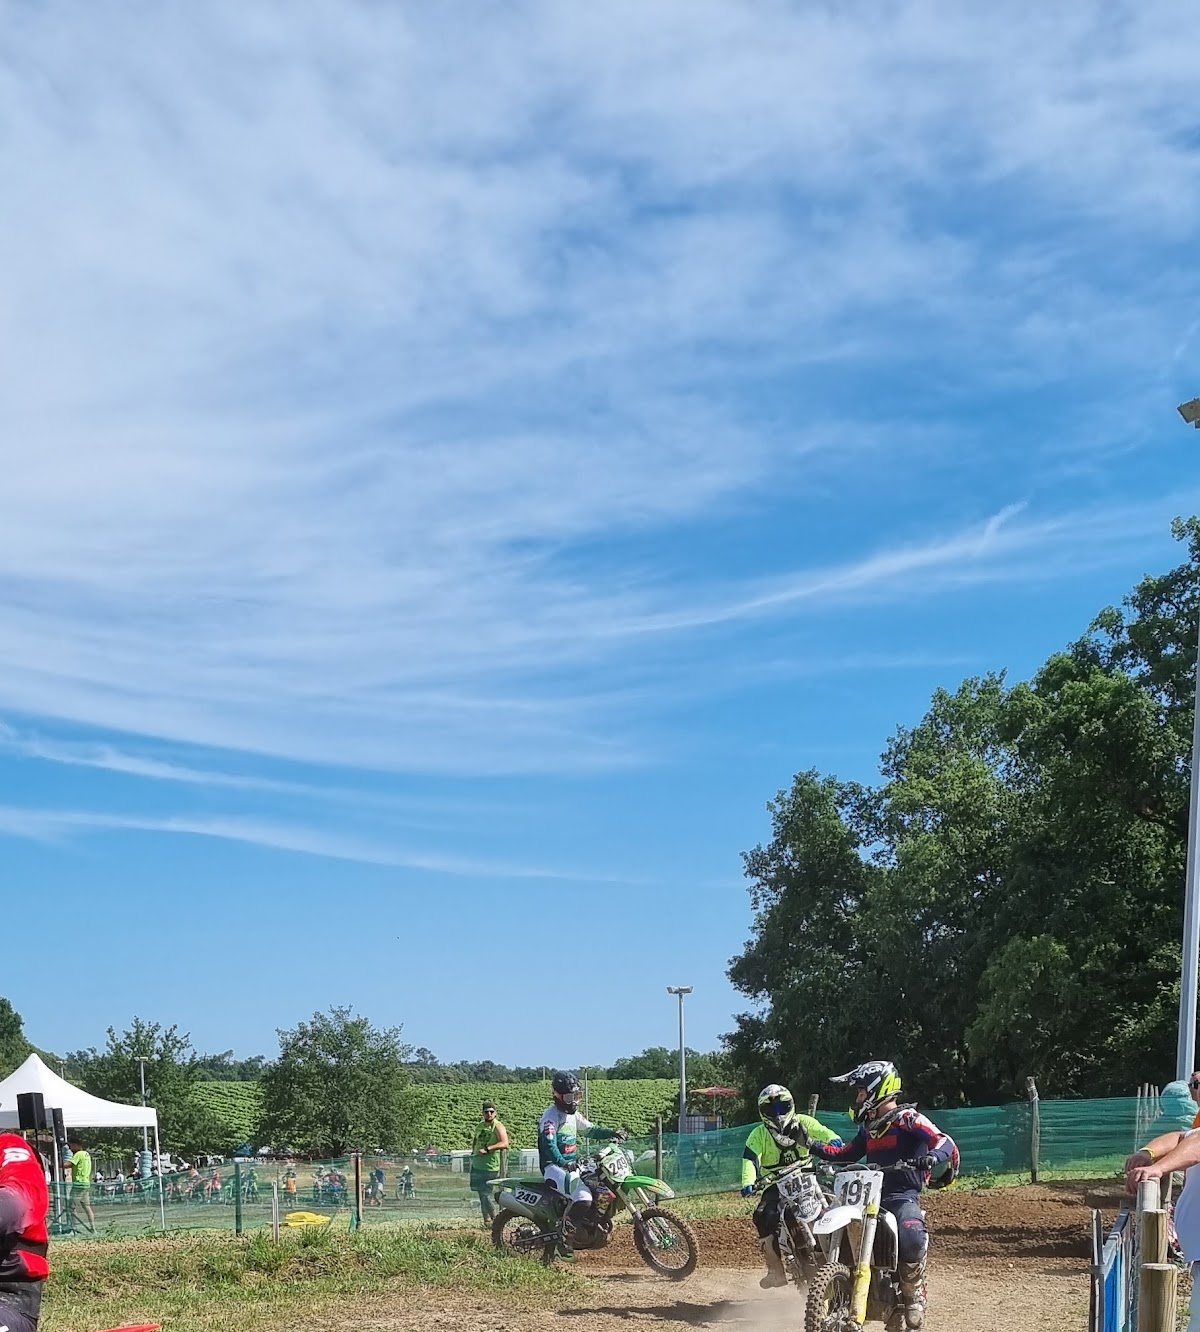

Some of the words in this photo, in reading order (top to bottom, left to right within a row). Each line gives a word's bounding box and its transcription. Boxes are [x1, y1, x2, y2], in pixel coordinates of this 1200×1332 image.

[608, 1156, 628, 1175] 249
[516, 1191, 538, 1204] 249
[841, 1179, 872, 1207] 191
